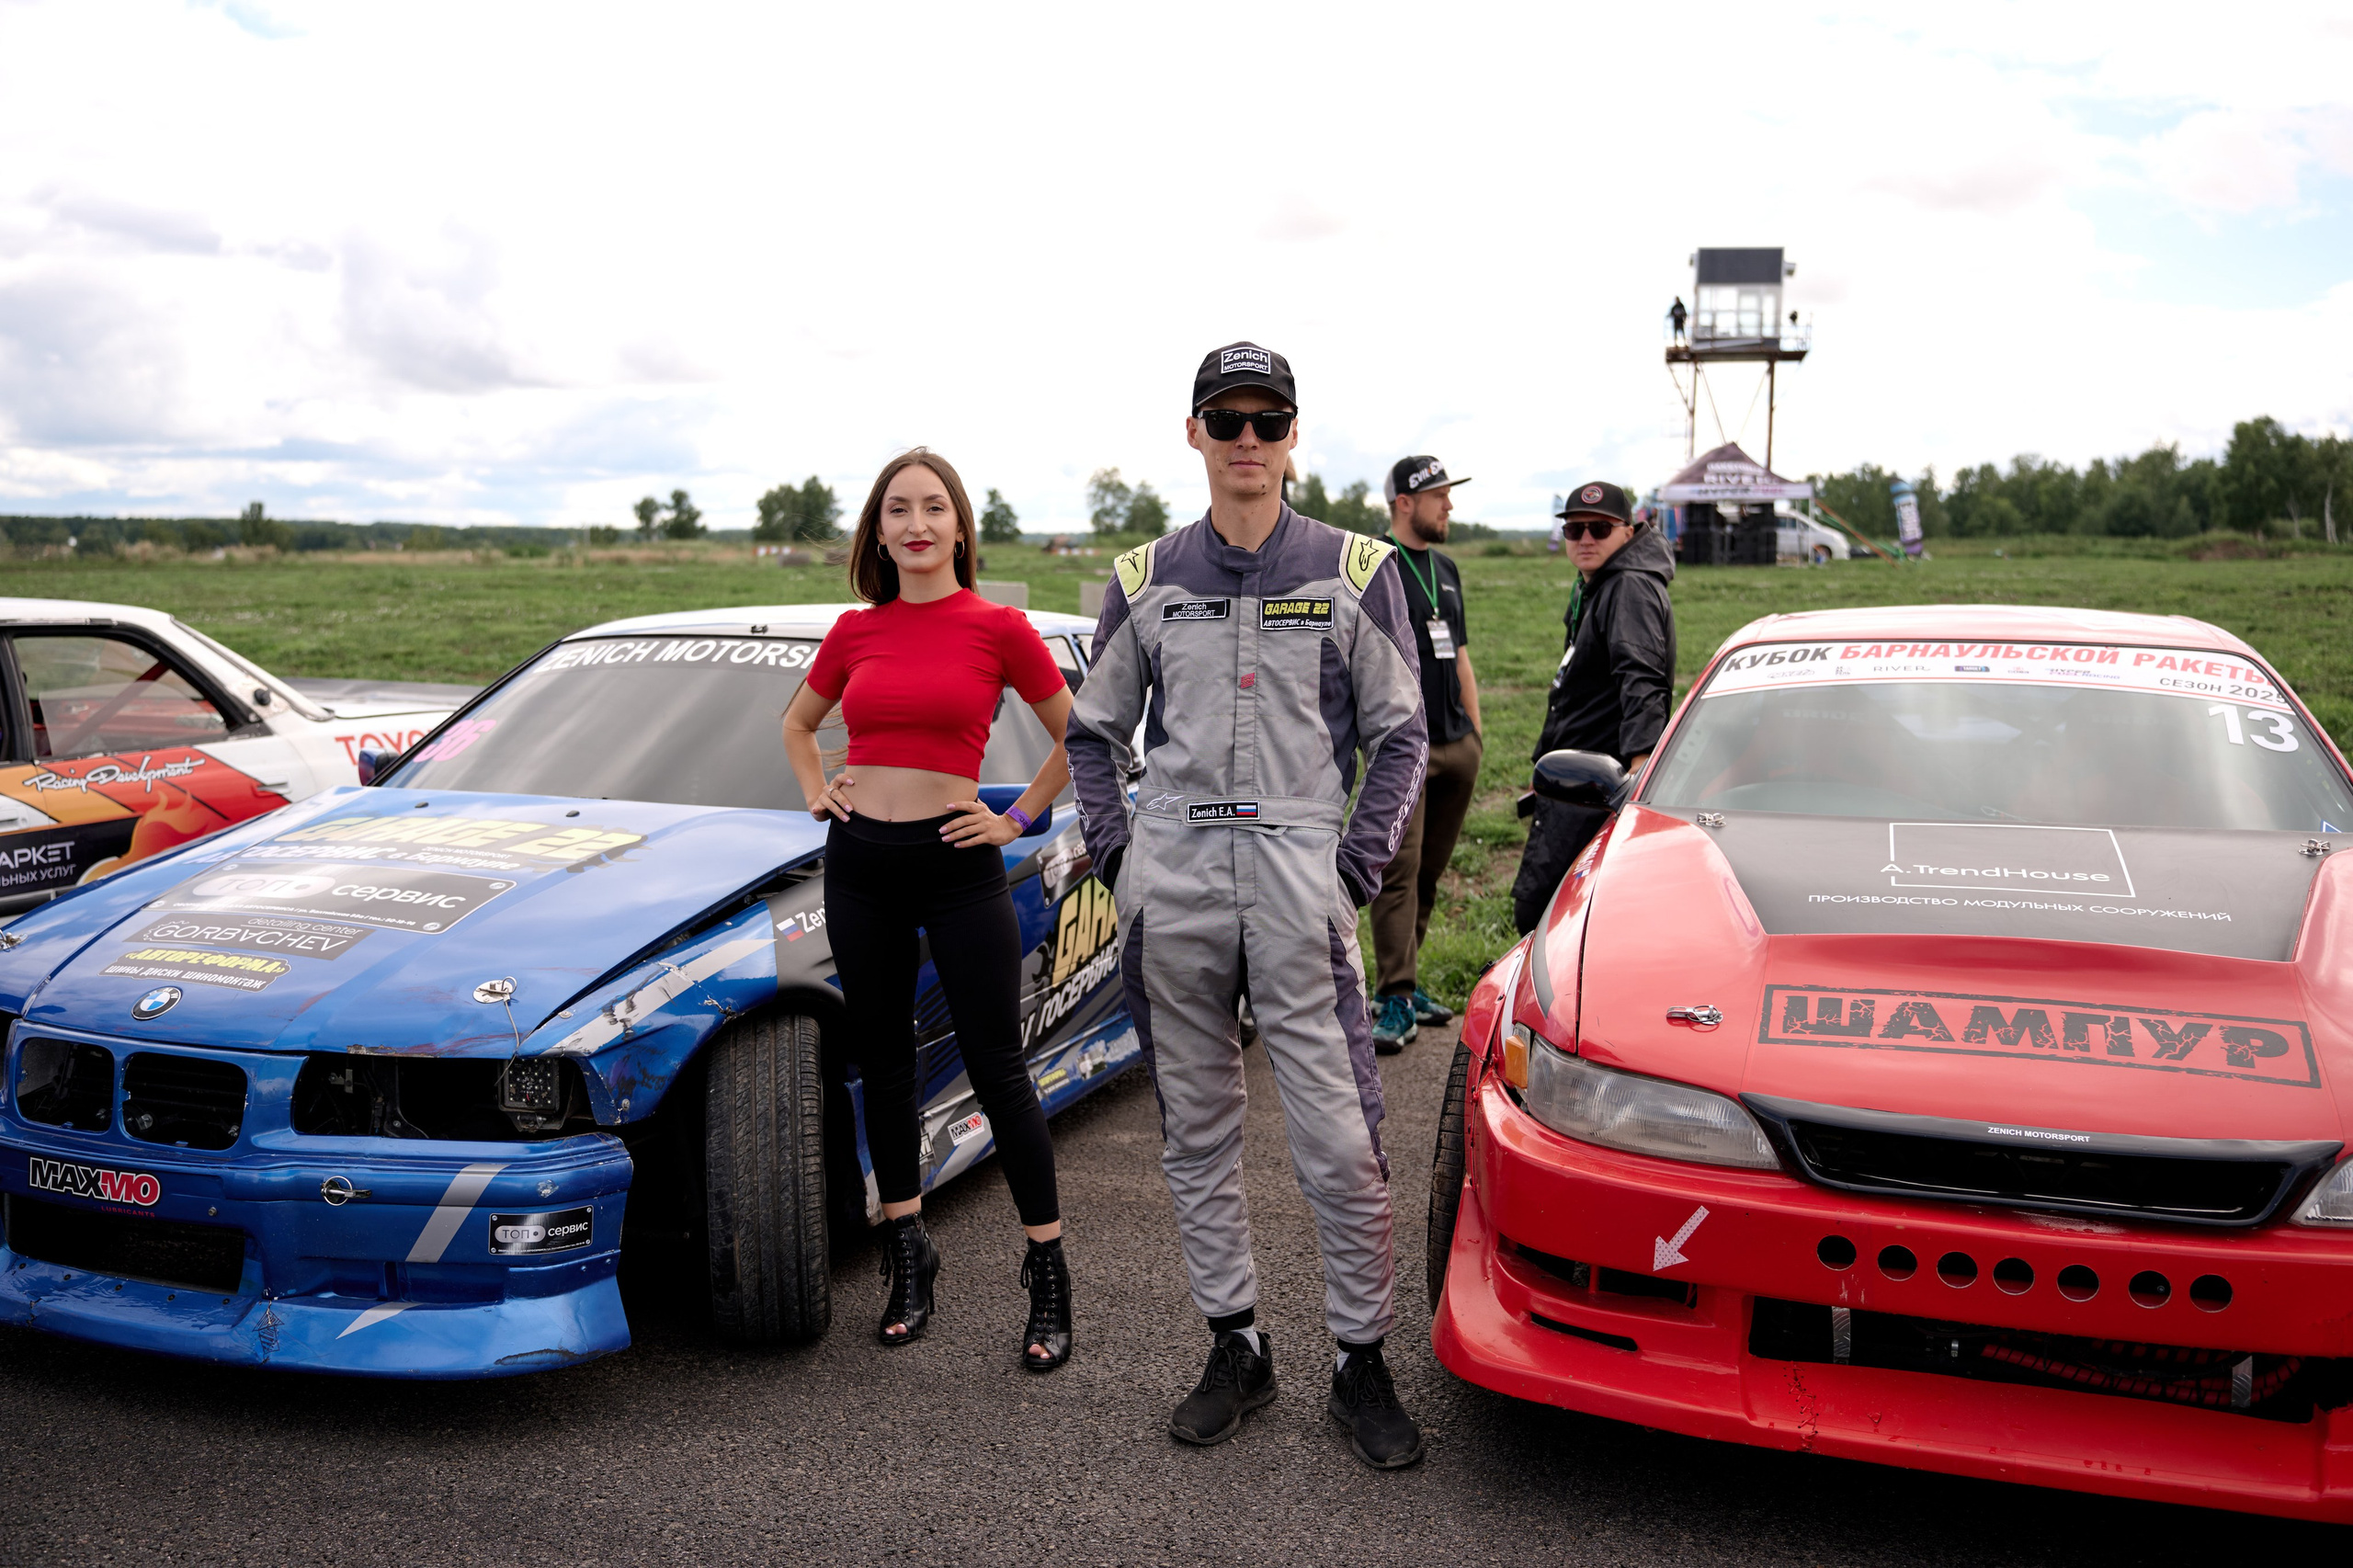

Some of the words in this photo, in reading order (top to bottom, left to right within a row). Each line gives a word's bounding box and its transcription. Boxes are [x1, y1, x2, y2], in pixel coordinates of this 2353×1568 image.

[1223, 349, 1267, 363] Zenich
[1224, 361, 1267, 370] MOTORSPORT
[1172, 609, 1215, 618] MOTORSPORT
[1182, 602, 1207, 610] Zenich
[1264, 601, 1311, 615] GARAGE
[1313, 602, 1330, 615] 22
[1263, 619, 1301, 627] АВТОСЕРВИС
[1305, 619, 1332, 629] Барнауле
[533, 641, 654, 674] ZENICH
[1724, 646, 1834, 673] КУБОК
[1839, 643, 2120, 665] БАРНАУЛЬСКОЙ
[2160, 677, 2222, 693] СЕЗОН
[2208, 703, 2300, 753] 13
[413, 718, 497, 763] 36
[1191, 806, 1217, 818] Zenich
[1219, 806, 1235, 817] E.A.
[274, 816, 551, 848] GARAGE
[501, 827, 643, 860] 22
[408, 851, 520, 869] Барнауле
[0, 870, 38, 887] ЬНЫХ
[40, 864, 76, 881] УСЛУГ
[1881, 864, 2110, 882] A.TrendHouse
[218, 879, 292, 892] ТОП
[332, 884, 466, 909] сервис
[795, 901, 825, 933] Zen
[1808, 894, 1958, 905] ПРОИЗВОДСТВО
[1963, 899, 2084, 912] МОДУЛЬНЫХ
[2089, 905, 2232, 922] СООРУЖЕНИЙ
[247, 917, 311, 932] detailing
[312, 922, 363, 936] center
[1051, 875, 1120, 988] GARA
[153, 925, 347, 952] GORBACHEV
[1781, 994, 2291, 1070] ШАМПУР
[1987, 1126, 2022, 1136] ZENICH
[2024, 1131, 2090, 1142] MOTORSPORT
[29, 1156, 161, 1207] MAXMO
[101, 1205, 155, 1218] LUBRICANTS
[502, 1229, 529, 1239] ТОП
[548, 1221, 588, 1237] сервис
